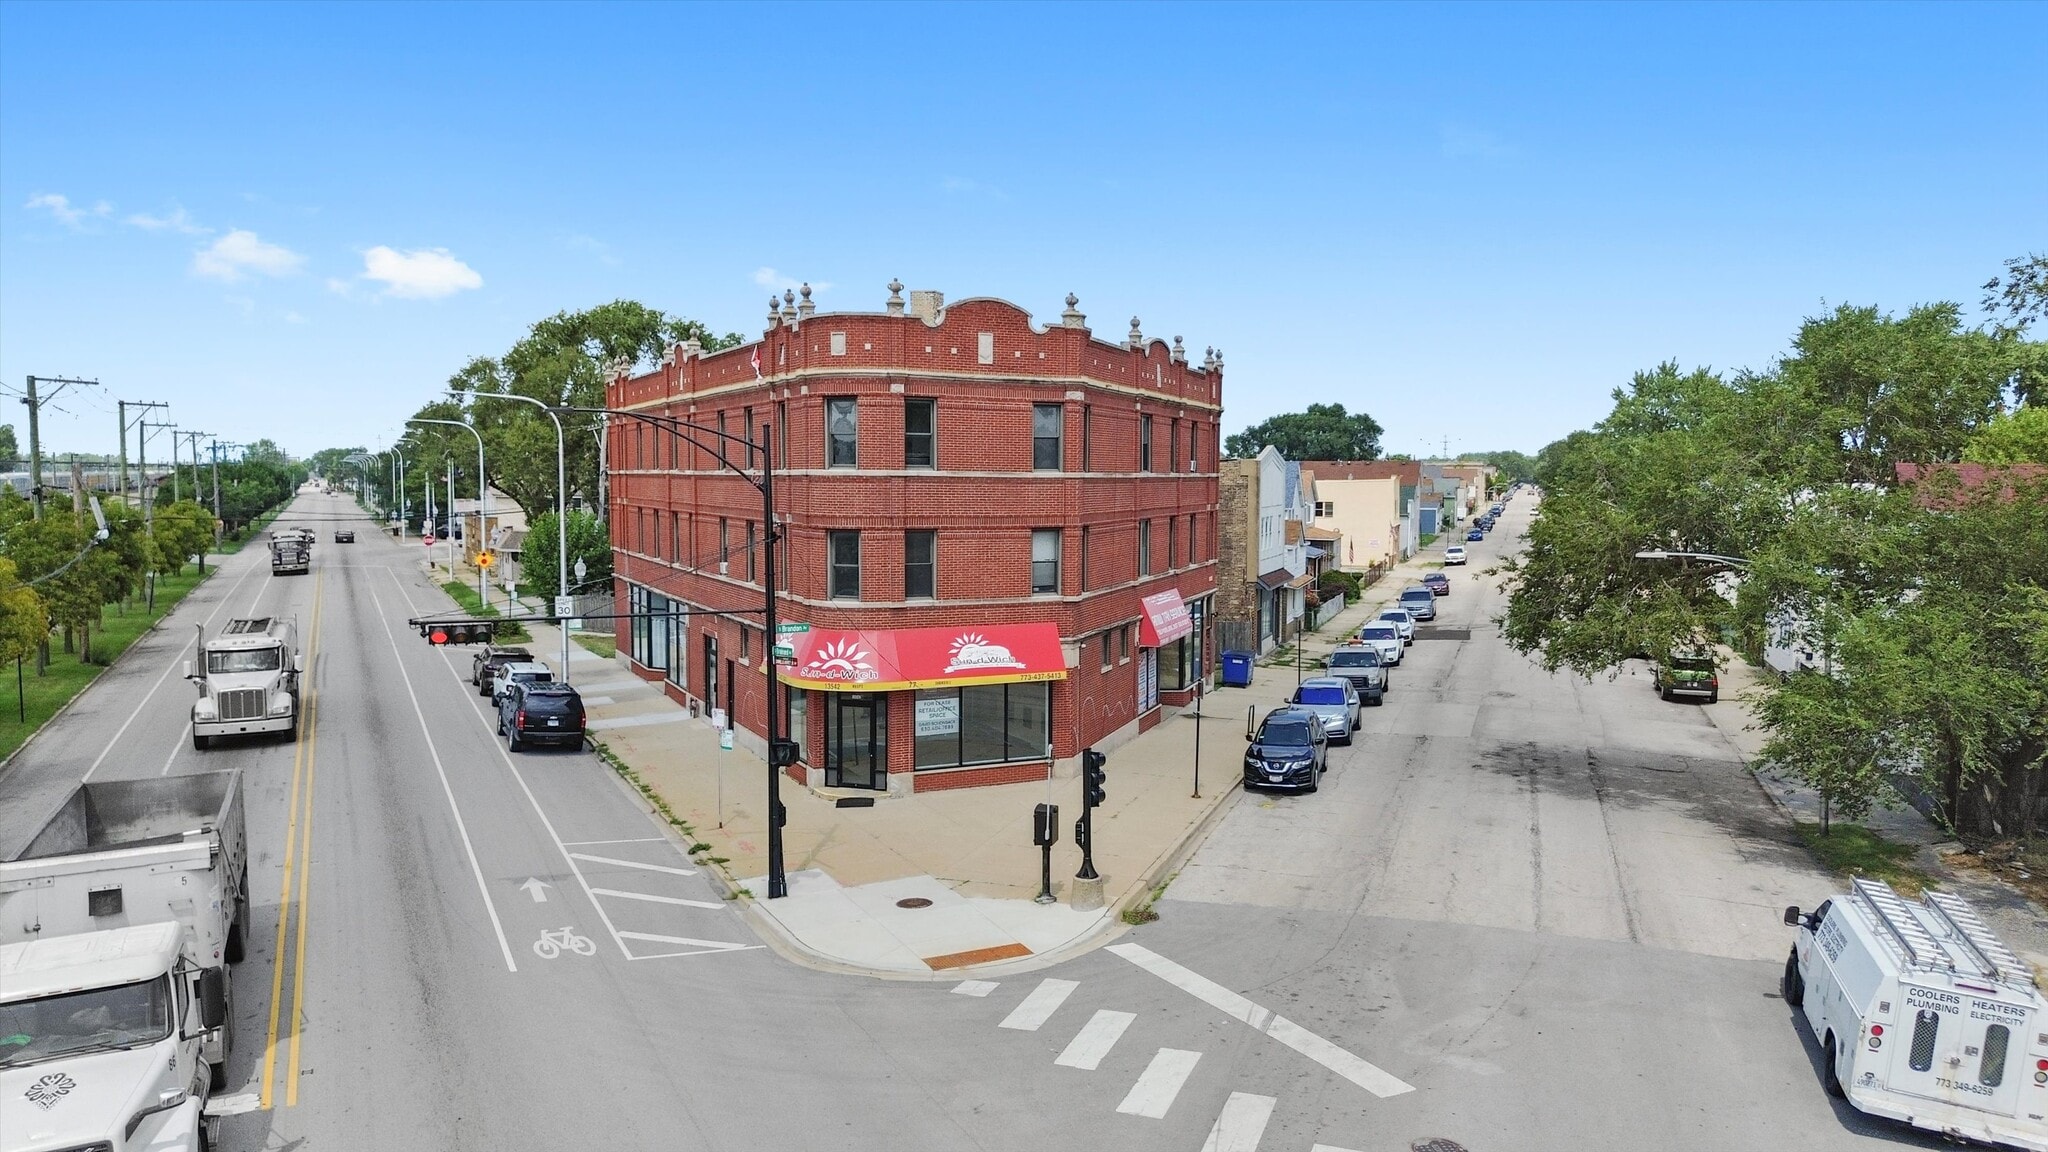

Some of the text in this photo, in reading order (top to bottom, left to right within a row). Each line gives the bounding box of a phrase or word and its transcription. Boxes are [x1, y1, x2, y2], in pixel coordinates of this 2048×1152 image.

[558, 606, 571, 615] 30
[781, 624, 803, 632] Brandon
[1020, 672, 1062, 681] 773-437-5413
[1909, 987, 1960, 1004] COOLERS
[1906, 997, 1959, 1015] PLUMBING
[1972, 1000, 2026, 1017] HEATERS
[1970, 1010, 2024, 1027] ELECTRICITY
[1935, 1077, 1994, 1097] 773 349-6259
